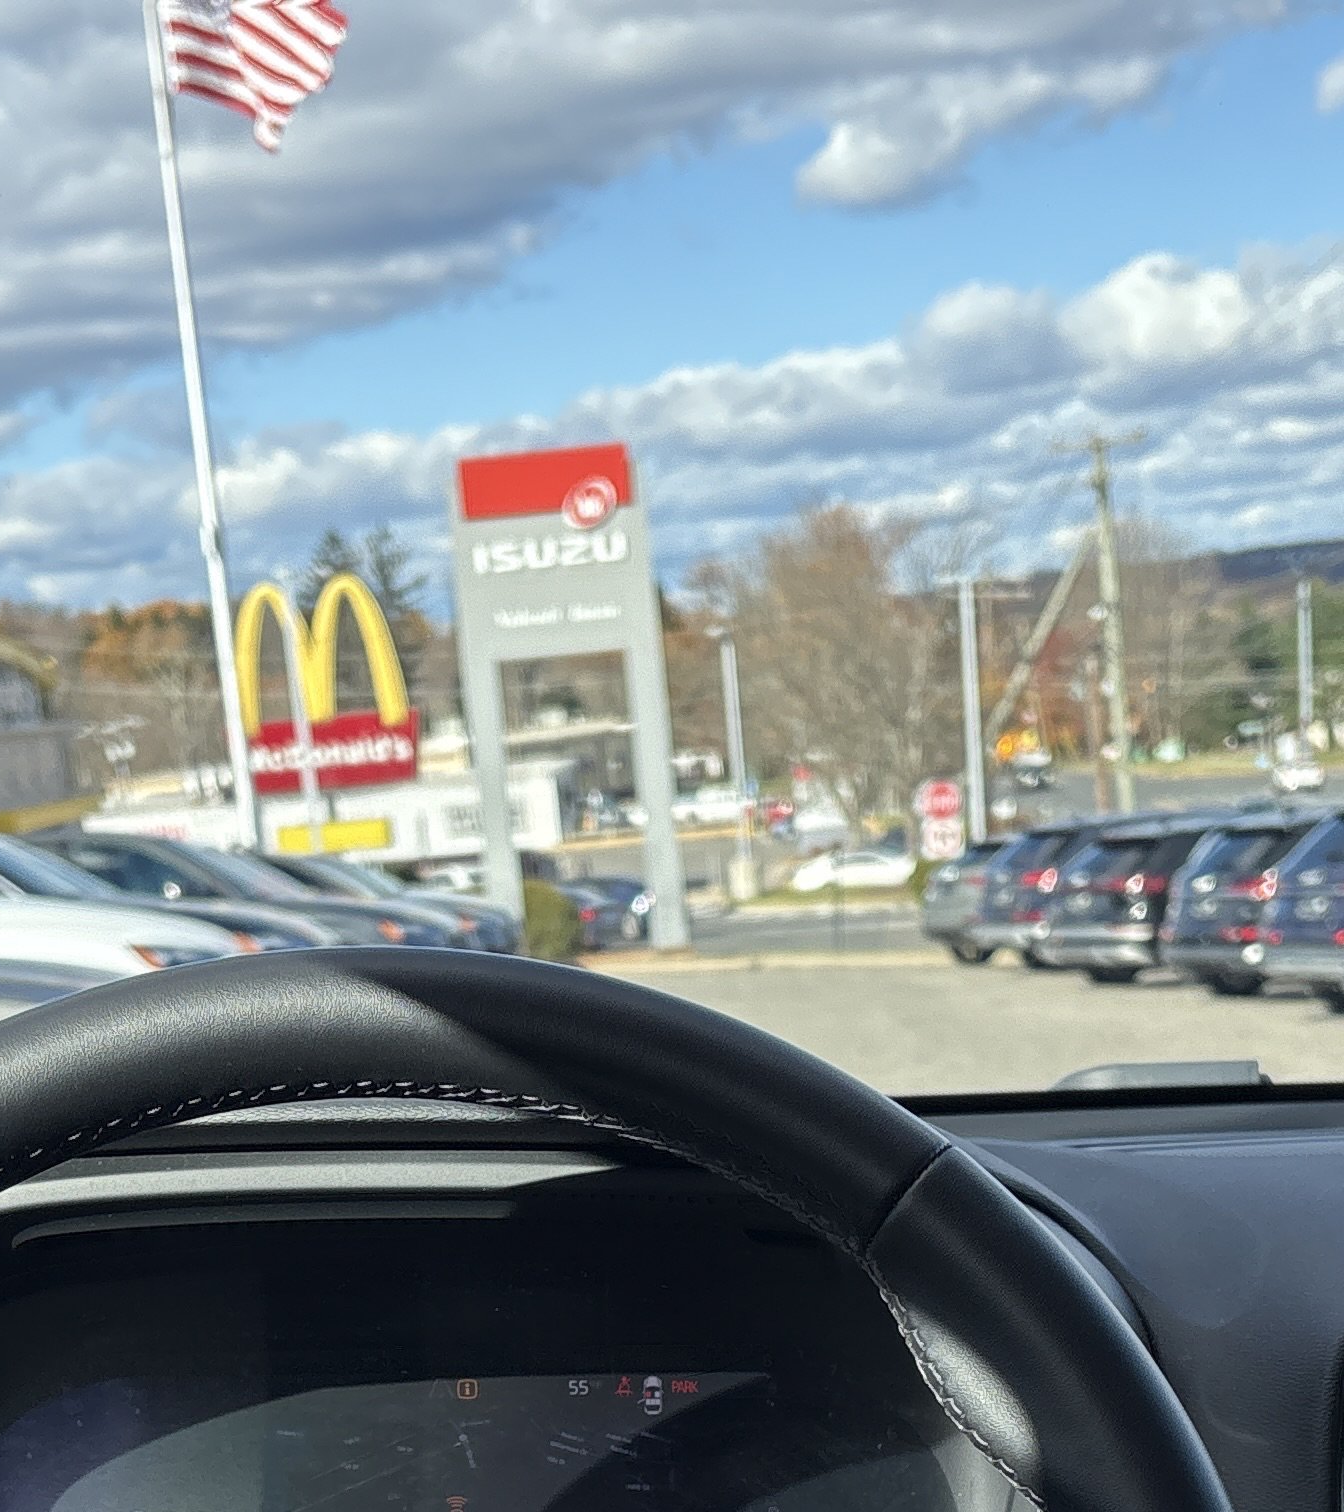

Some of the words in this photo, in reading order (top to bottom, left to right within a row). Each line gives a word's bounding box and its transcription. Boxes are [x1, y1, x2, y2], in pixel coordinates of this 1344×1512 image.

[472, 531, 628, 574] ISUZU
[568, 1380, 589, 1396] 55
[671, 1380, 699, 1393] PARK
